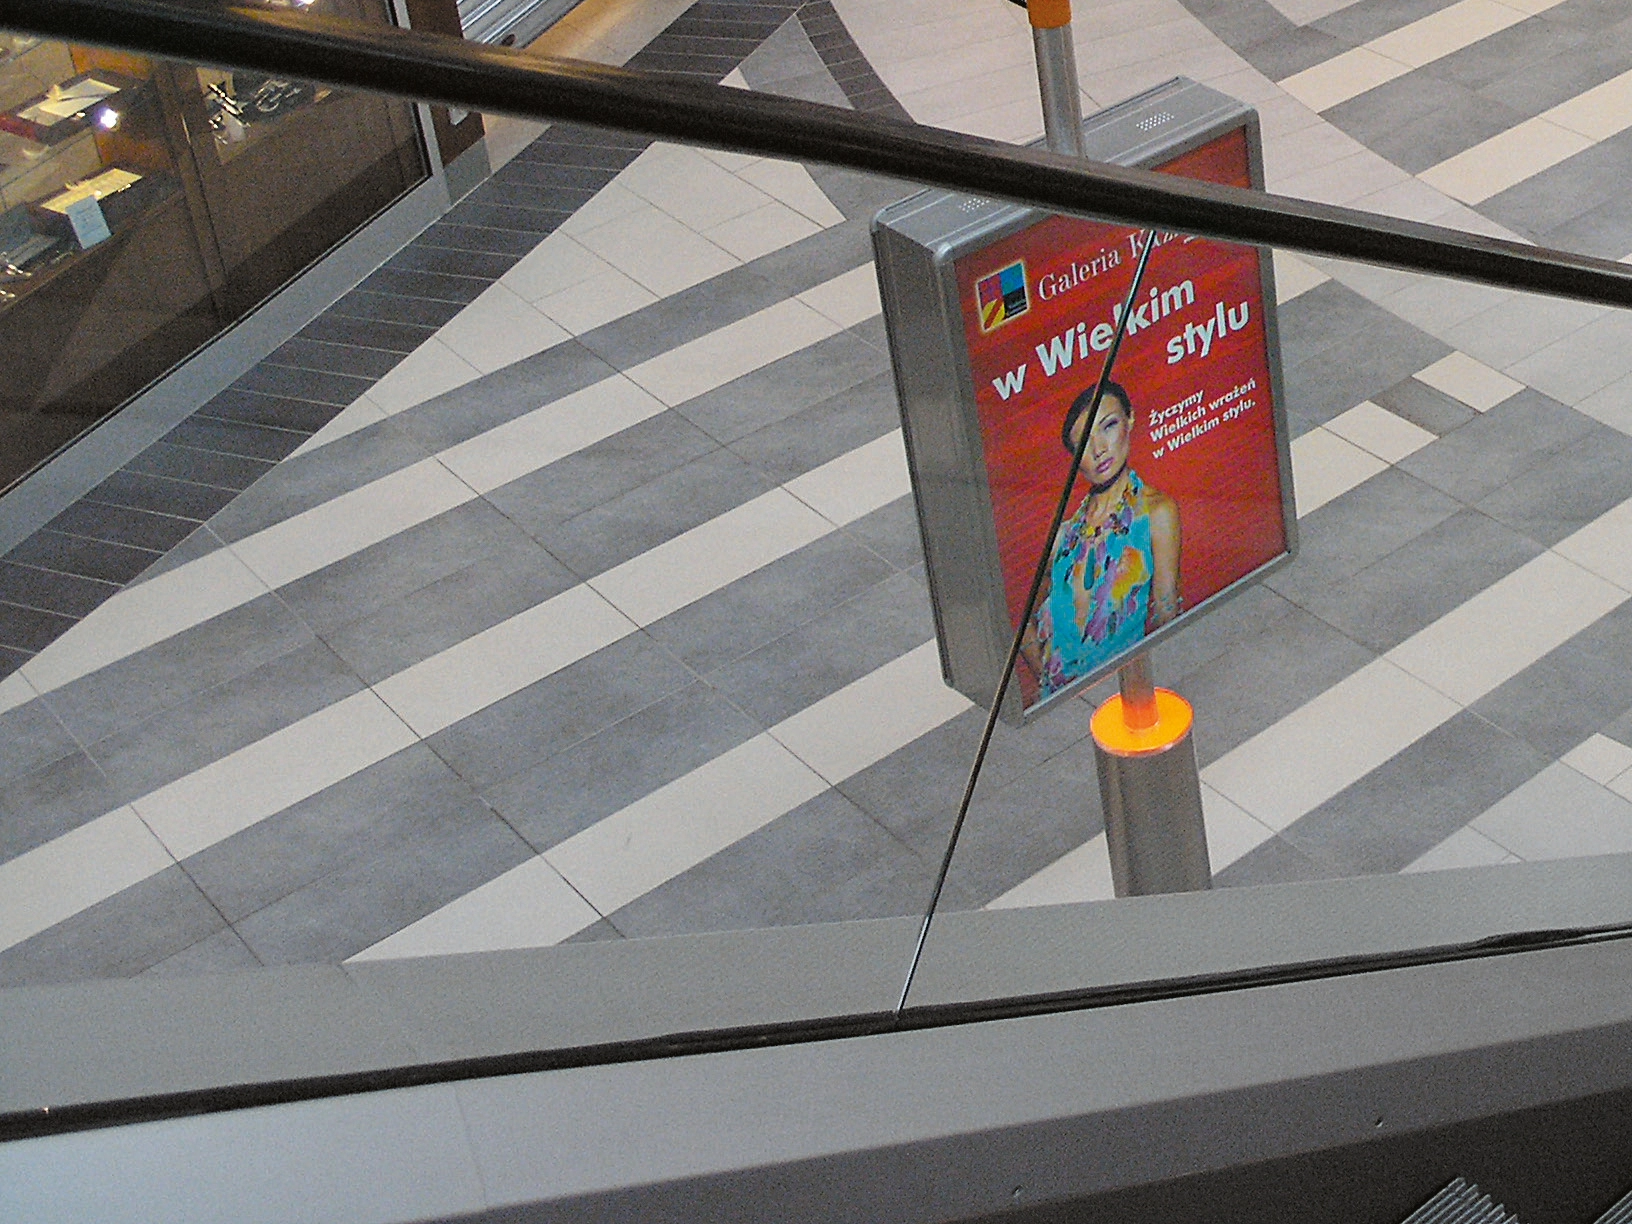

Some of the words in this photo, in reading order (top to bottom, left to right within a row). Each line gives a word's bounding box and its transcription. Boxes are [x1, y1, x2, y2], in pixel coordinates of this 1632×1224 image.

[1038, 248, 1121, 301] Galeria
[992, 364, 1027, 401] w
[1035, 279, 1195, 377] Wielkim
[1166, 301, 1249, 365] stylu
[1149, 389, 1204, 426] Życzymy
[1150, 405, 1206, 442] Wielkich
[1152, 447, 1164, 459] w
[1167, 416, 1219, 451] Wielkim
